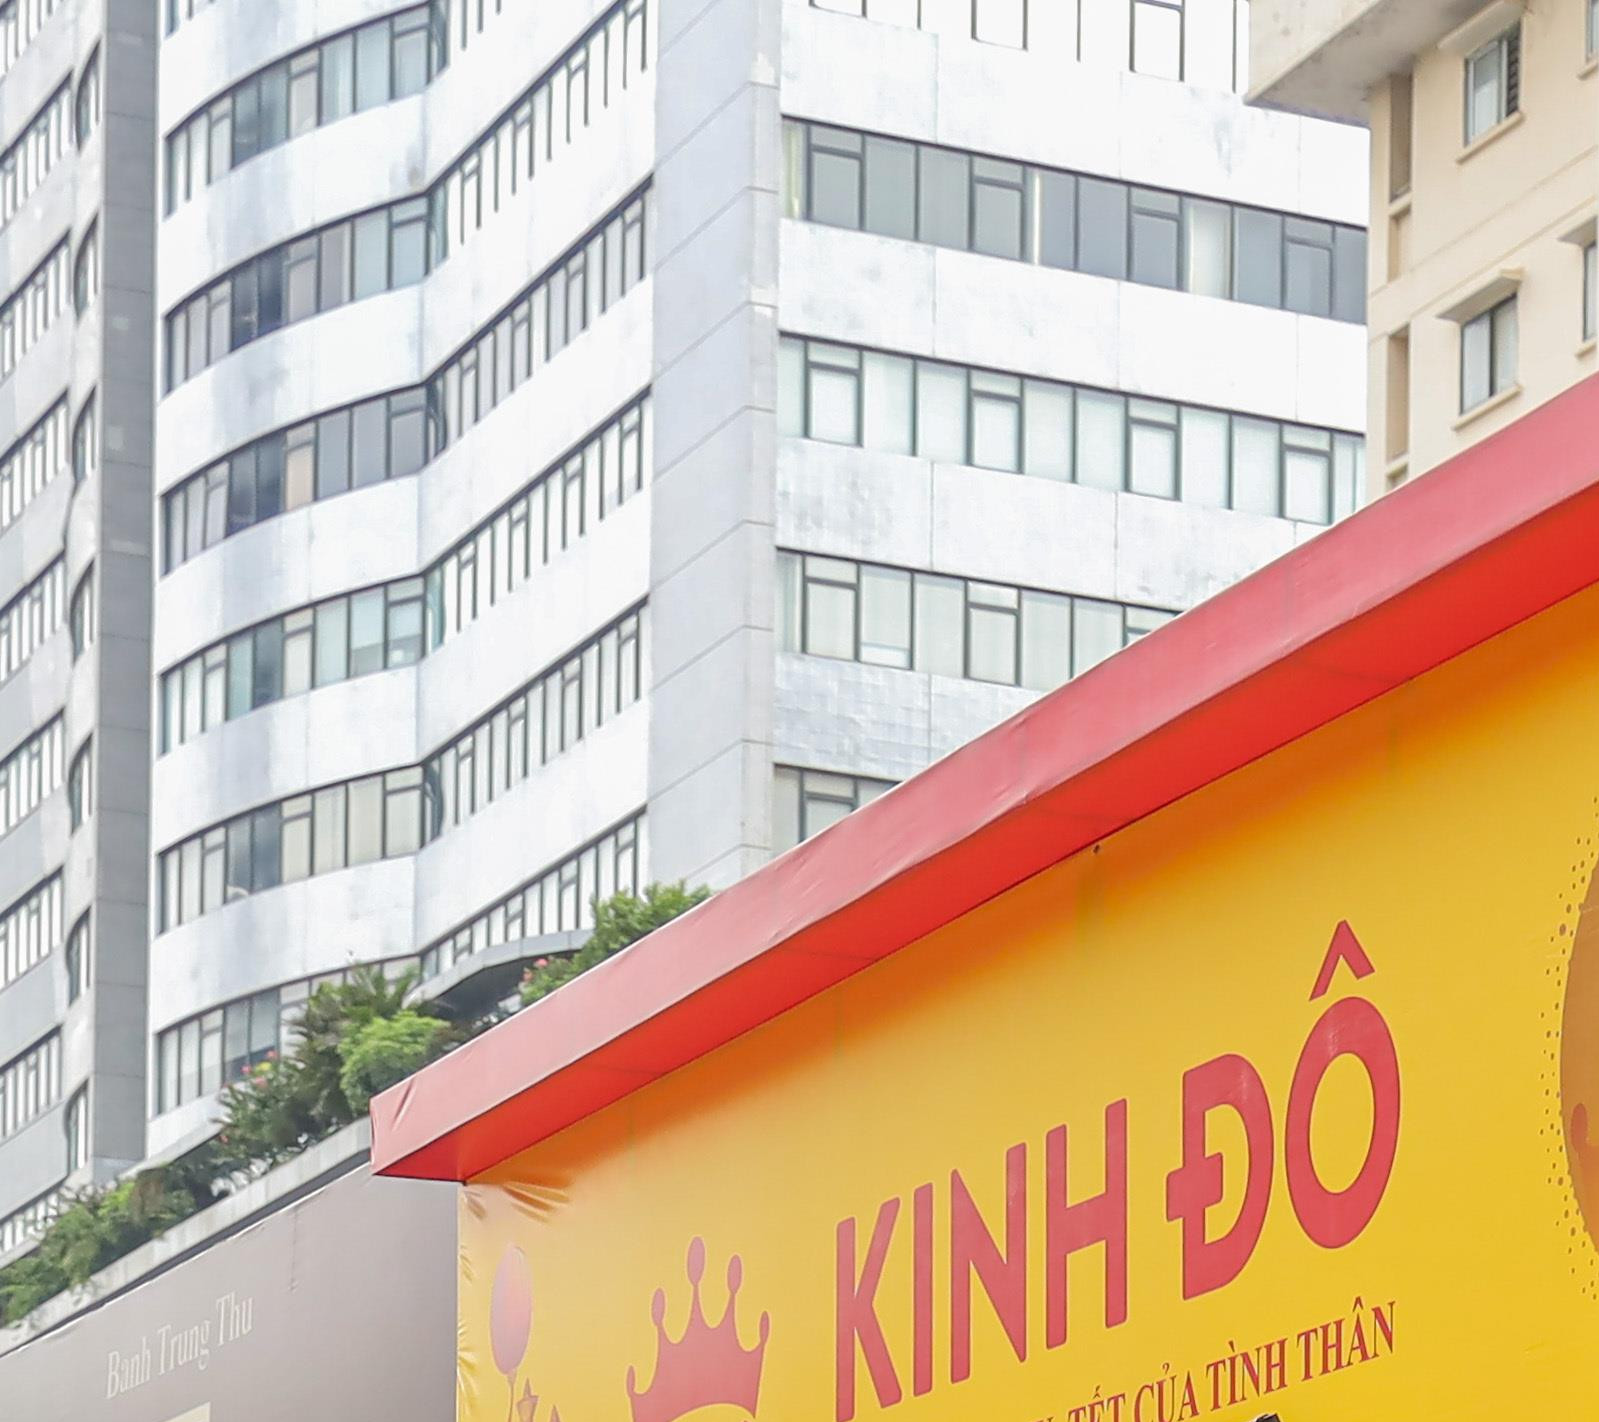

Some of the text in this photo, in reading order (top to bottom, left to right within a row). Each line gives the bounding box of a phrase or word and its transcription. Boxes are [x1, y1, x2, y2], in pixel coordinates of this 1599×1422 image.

[1166, 919, 1401, 1300] ĐÔ
[157, 1320, 211, 1377] Trung
[216, 1291, 254, 1347] Thu
[1205, 1334, 1288, 1418] TÌNH
[1296, 1299, 1397, 1385] THÂN
